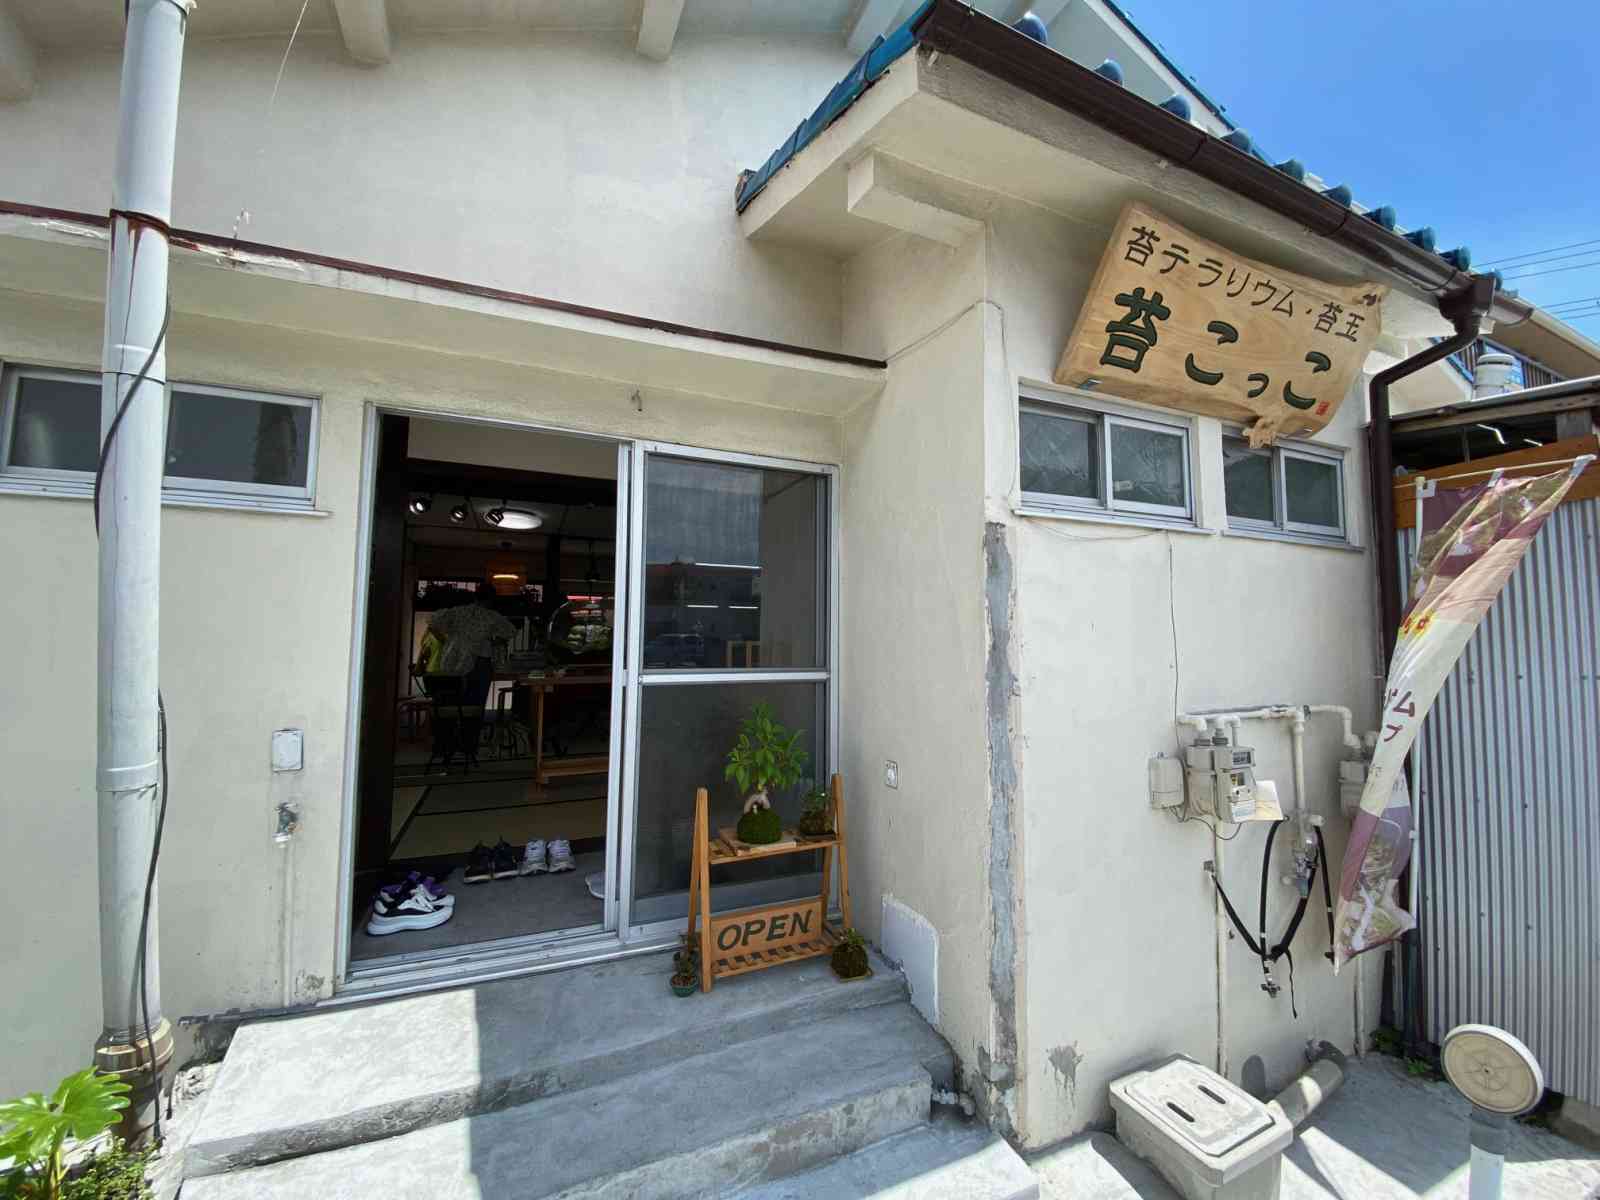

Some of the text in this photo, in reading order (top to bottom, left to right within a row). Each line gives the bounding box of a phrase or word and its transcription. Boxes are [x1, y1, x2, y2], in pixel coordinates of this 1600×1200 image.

[1100, 287, 1332, 410] 苔こっこ
[717, 909, 813, 951] OPEN
